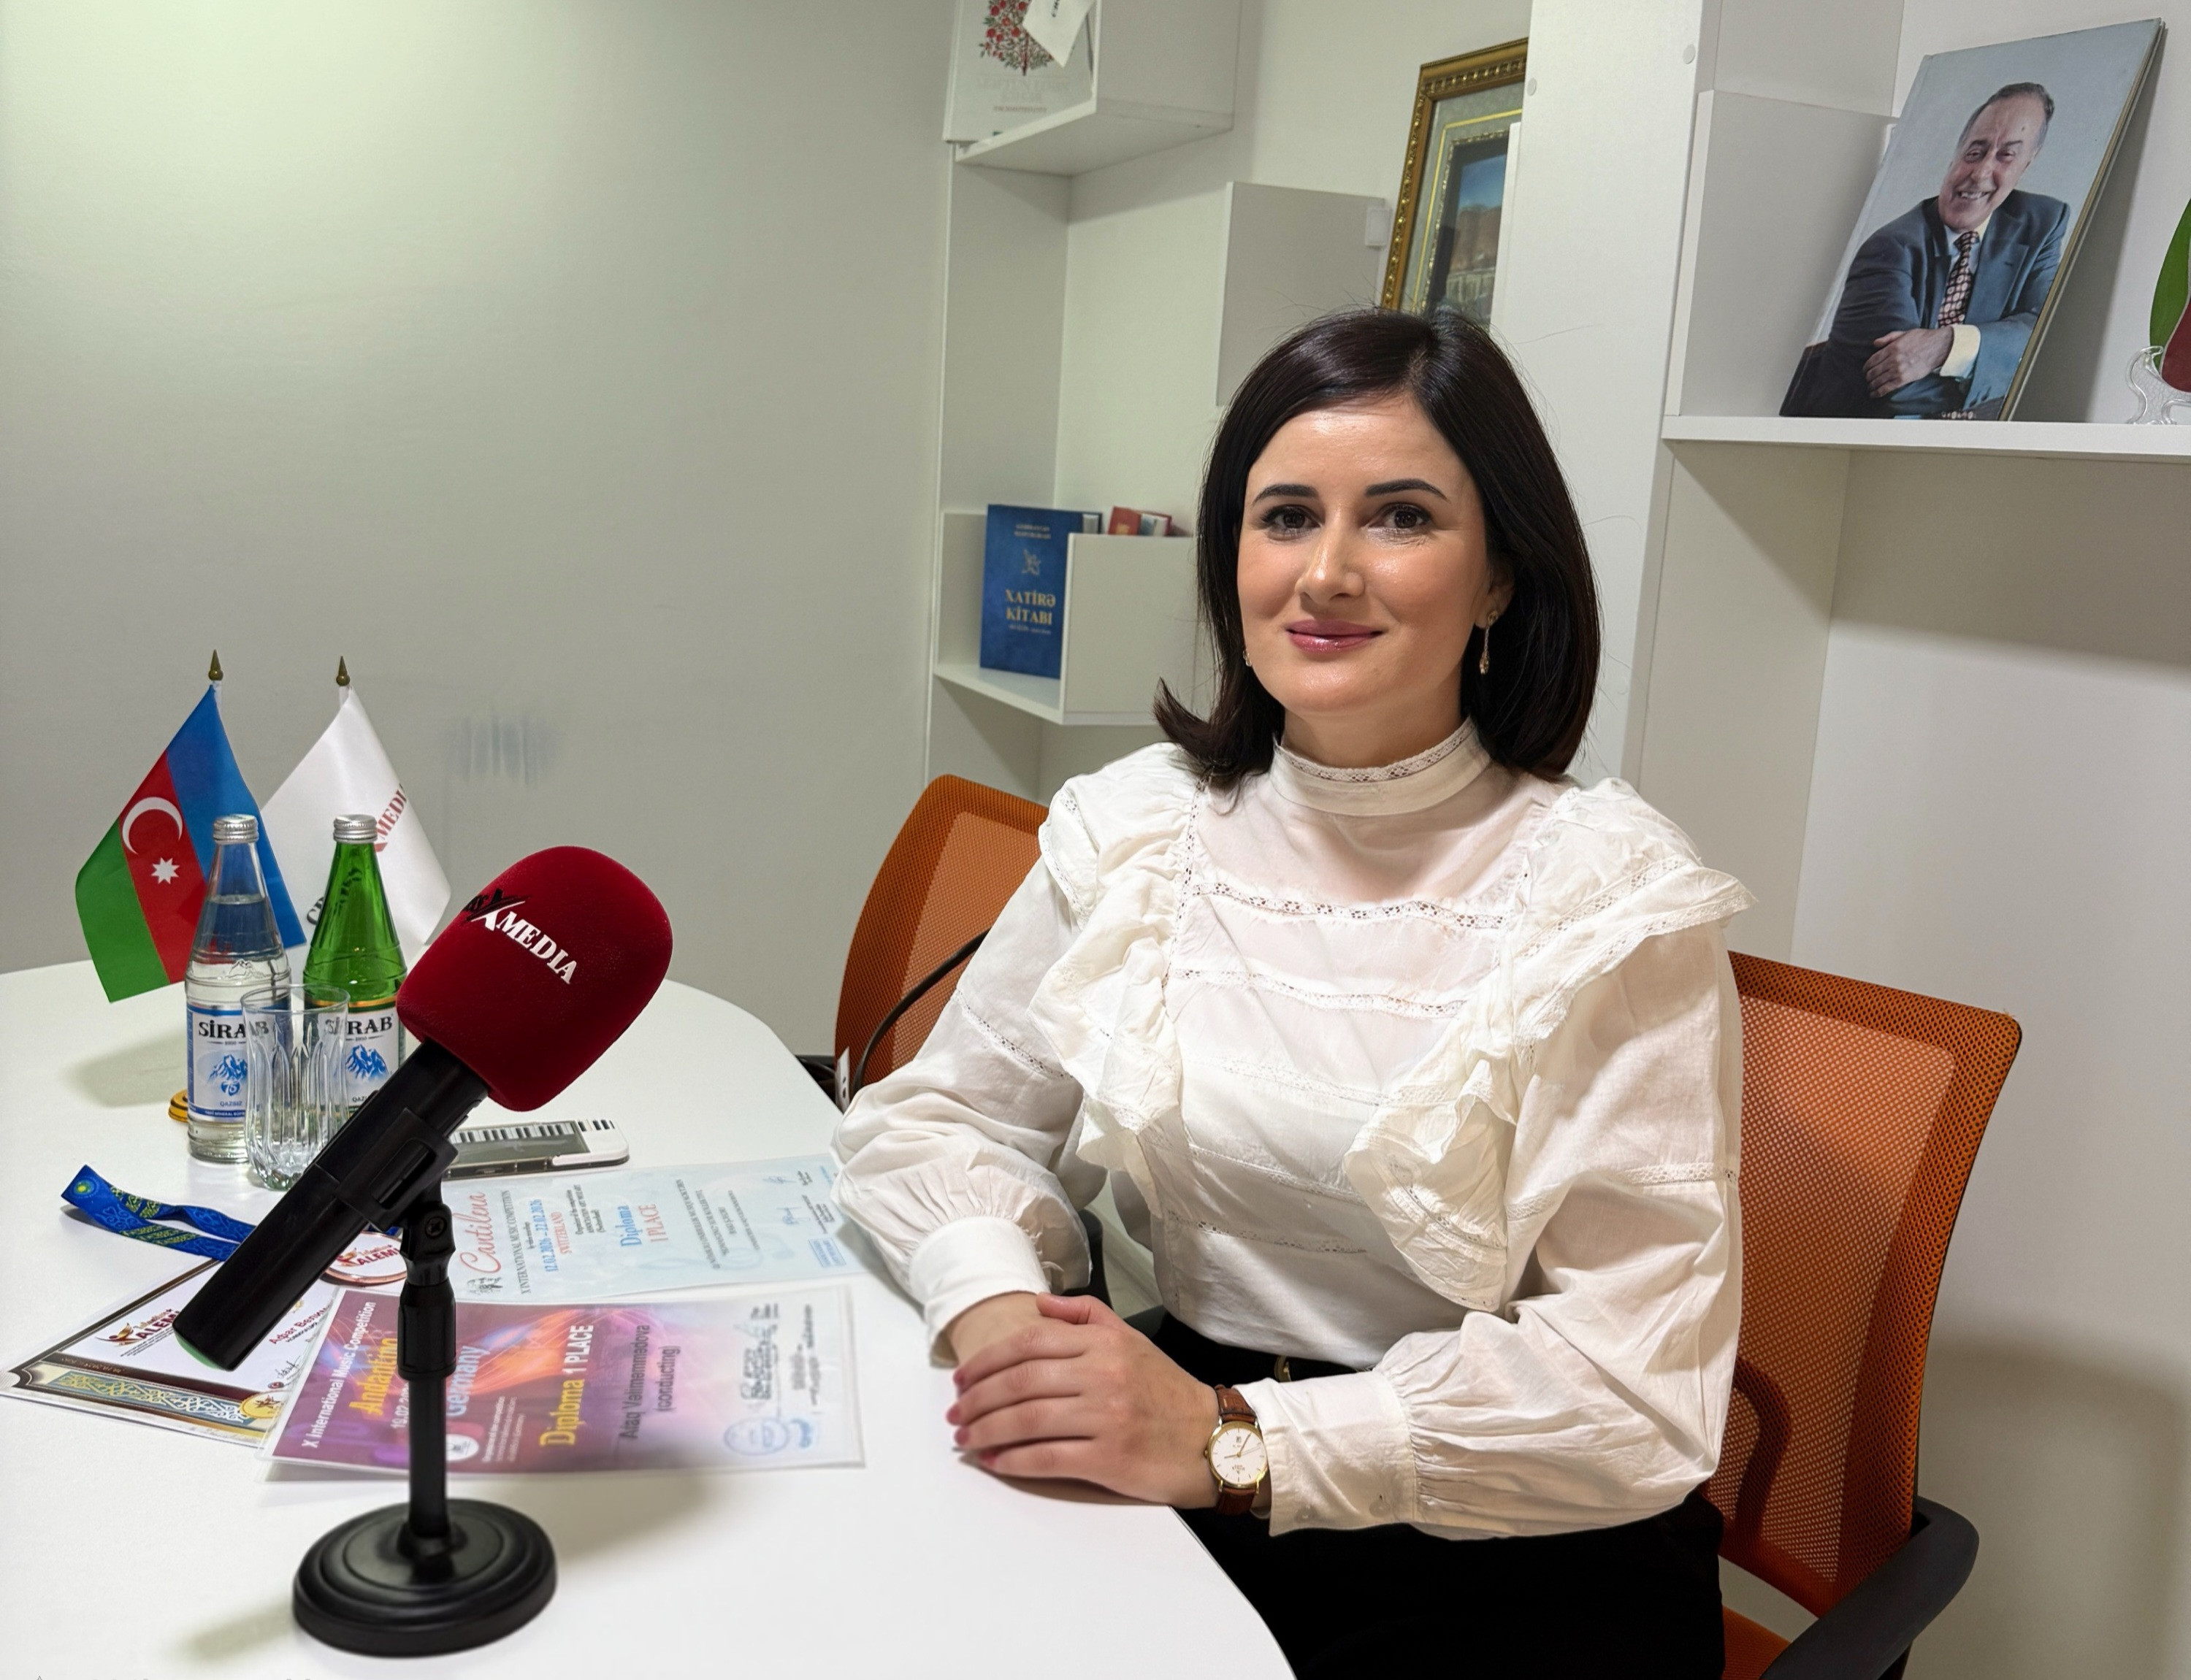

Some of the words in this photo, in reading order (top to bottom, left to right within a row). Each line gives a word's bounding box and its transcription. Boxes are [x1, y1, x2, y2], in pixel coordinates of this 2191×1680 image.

[1006, 607, 1052, 625] KİTABI
[500, 1189, 517, 1225] COMPETITION
[615, 1205, 643, 1247] Diploma
[638, 1204, 666, 1237] PLACE
[452, 1192, 502, 1274] Cantilena
[508, 1224, 521, 1242] MUSIC
[550, 1211, 572, 1254] SWITZERLAND
[511, 1241, 530, 1289] INTERNATIONAL
[343, 1301, 376, 1351] Competition
[333, 1349, 356, 1378] Music
[348, 1337, 398, 1416] Andantino
[446, 1345, 491, 1417] Germany
[539, 1378, 586, 1447] Diploma
[563, 1324, 594, 1365] PLACE
[656, 1344, 681, 1412] (conducting)
[310, 1377, 345, 1438] International
[302, 1438, 318, 1449] X
